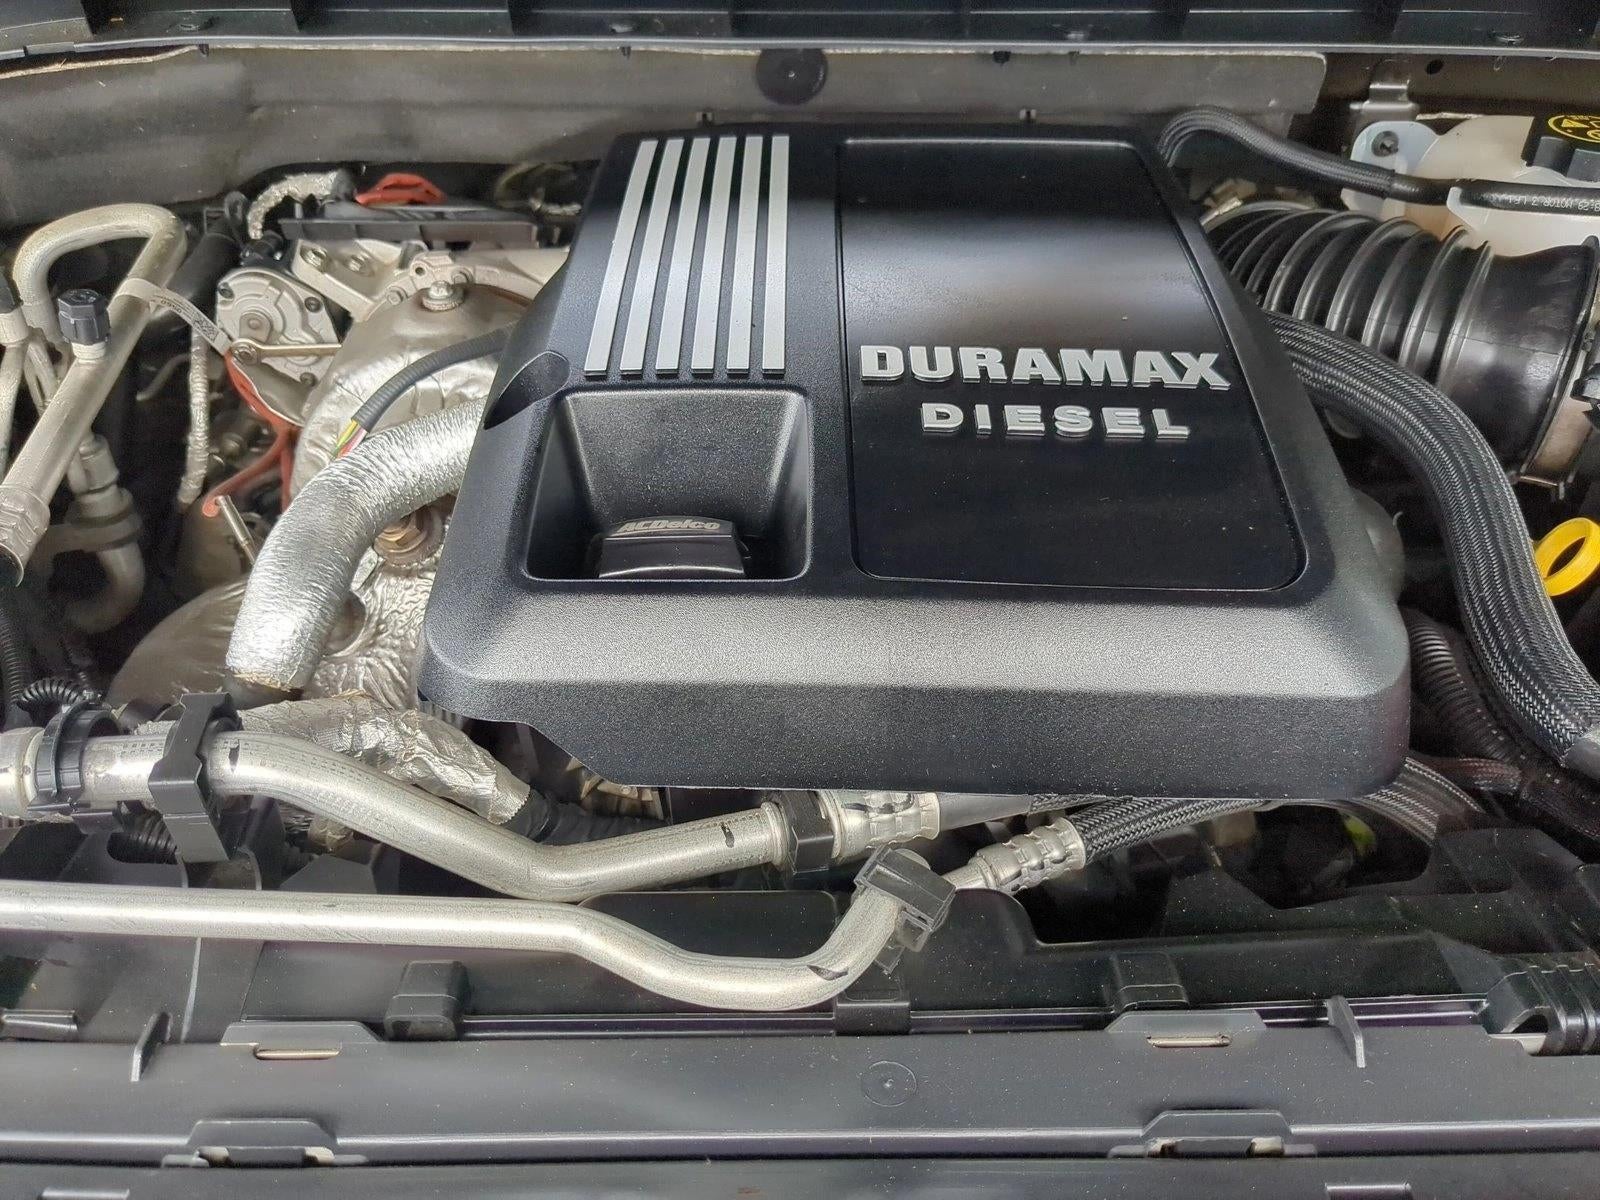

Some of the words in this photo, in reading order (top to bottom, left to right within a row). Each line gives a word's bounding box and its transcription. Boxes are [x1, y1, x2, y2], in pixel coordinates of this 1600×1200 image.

[860, 344, 1231, 391] DURAMAX
[921, 402, 1191, 438] DIESEL
[617, 519, 720, 533] ACDelco
